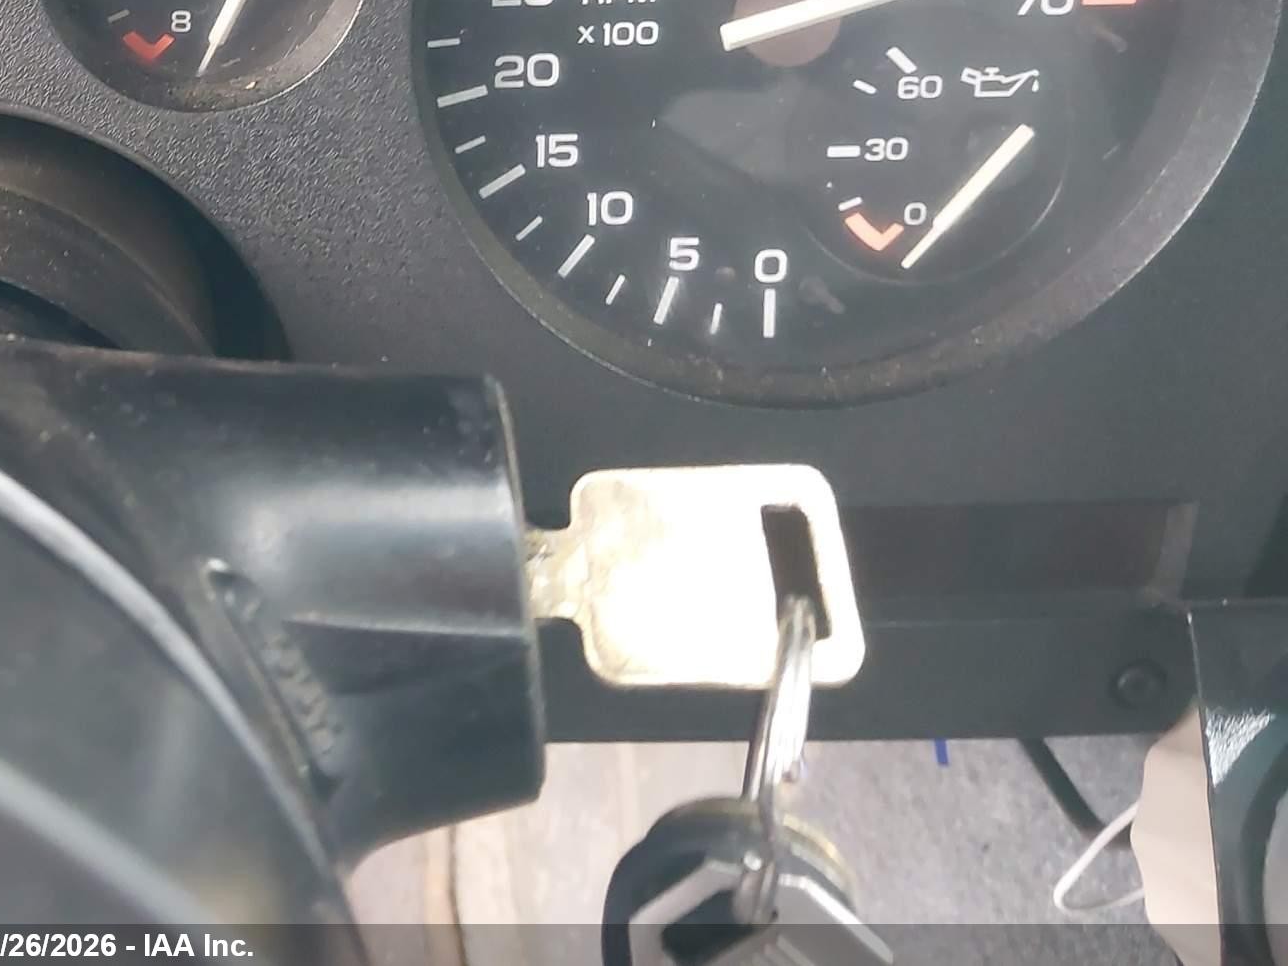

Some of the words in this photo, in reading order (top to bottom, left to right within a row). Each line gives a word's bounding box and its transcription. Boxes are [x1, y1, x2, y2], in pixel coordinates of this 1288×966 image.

[171, 10, 192, 32] 8
[603, 21, 659, 46] 100
[494, 54, 560, 87] 20
[897, 75, 943, 100] 60
[535, 134, 579, 168] 15
[864, 137, 909, 161] 30
[587, 191, 634, 226] 10
[904, 202, 927, 228] 0
[668, 237, 699, 271] 5
[754, 249, 788, 283] 0
